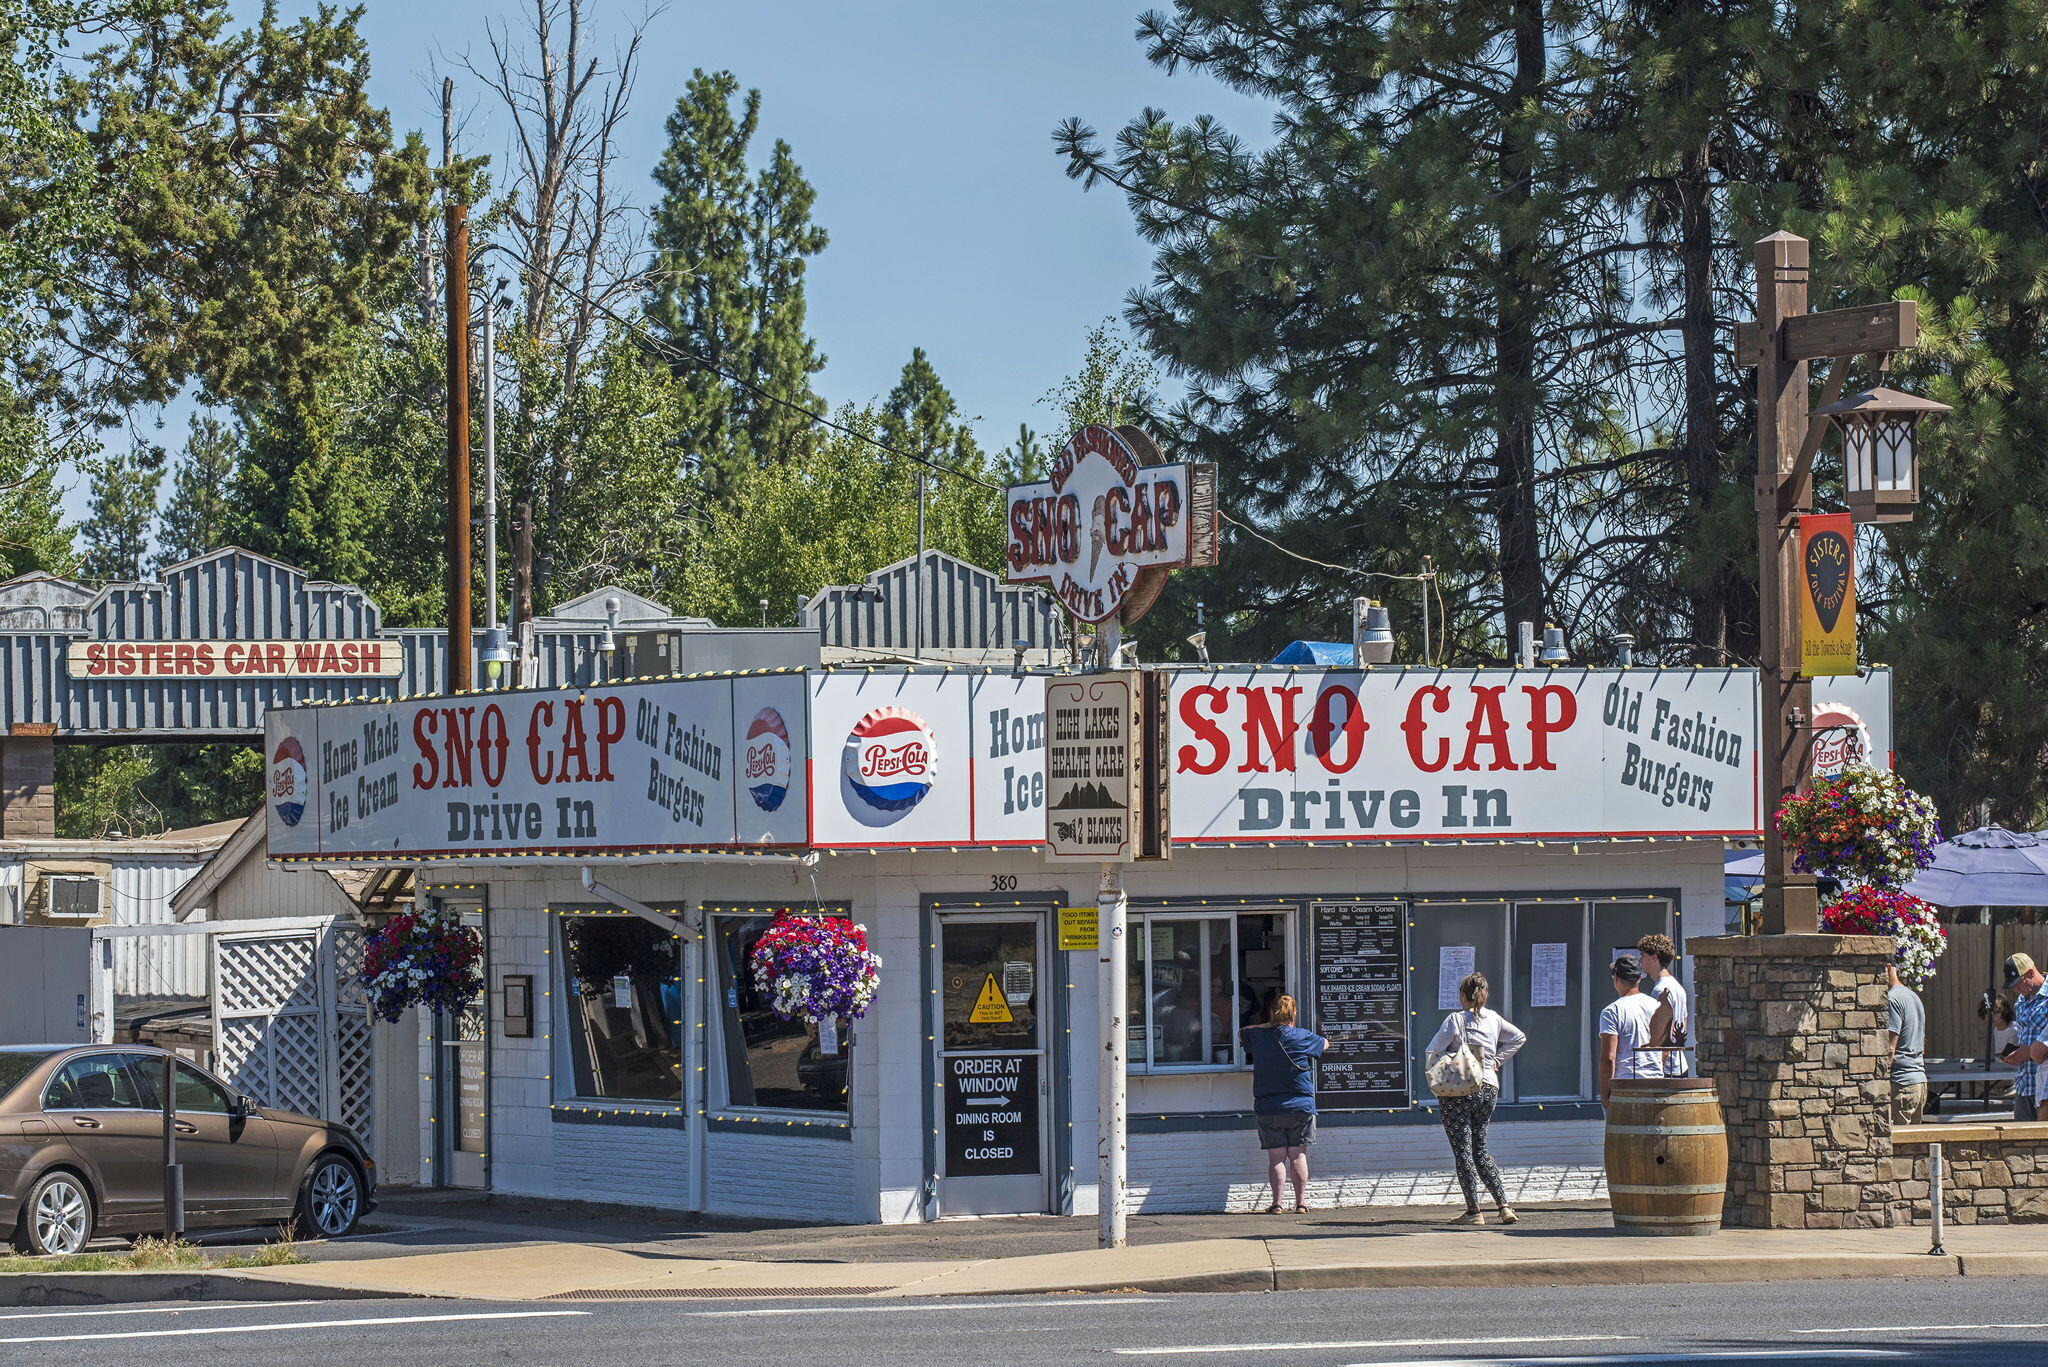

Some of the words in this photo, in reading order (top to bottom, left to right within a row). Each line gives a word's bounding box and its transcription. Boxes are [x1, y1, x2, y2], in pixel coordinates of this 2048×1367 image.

[1007, 493, 1082, 572] SNO
[1104, 480, 1181, 556] CAP
[1810, 537, 1846, 568] SISTERS
[1059, 573, 1105, 618] DRIVE
[1107, 562, 1132, 603] IN
[1810, 573, 1822, 605] FOLK
[1823, 570, 1846, 610] FESTIVAL
[86, 644, 216, 676] SISTERS
[224, 643, 286, 675] CAR
[295, 643, 382, 674] WASH
[412, 703, 509, 790] SNO
[526, 695, 626, 787] CAP
[635, 697, 659, 748] Old
[666, 712, 721, 782] Fashion
[990, 708, 1046, 759] Hom
[1056, 709, 1080, 740] HIGH
[1085, 707, 1120, 739] LAKES
[1177, 685, 1370, 775] SNO
[1400, 684, 1578, 772] CAP
[1603, 682, 1640, 734] Old
[1652, 698, 1742, 768] Fashion
[323, 738, 358, 784] Home
[363, 713, 399, 769] Made
[1052, 747, 1091, 778] HEALTH
[1094, 745, 1124, 777] CARE
[647, 759, 705, 828] Burgers
[1004, 766, 1043, 815] Ice
[1620, 743, 1714, 813] Burgers
[330, 790, 349, 833] Ice
[357, 769, 399, 820] Cream
[447, 792, 542, 842] Drive
[556, 796, 597, 838] In
[1238, 778, 1421, 831] Drive
[1442, 785, 1512, 827] In
[1077, 820, 1083, 844] 2
[1087, 817, 1122, 844] BLOCKS
[989, 875, 1018, 891] 380
[459, 1050, 477, 1062] ORDER
[460, 1066, 482, 1079] WINDOW
[954, 1059, 1002, 1075] ORDER
[1004, 1058, 1022, 1073] AT
[958, 1077, 1018, 1093] WINDOW
[463, 1128, 481, 1138] CLOSED
[956, 1112, 989, 1125] DINING
[992, 1111, 1021, 1124] ROOM
[983, 1130, 995, 1141] IS
[965, 1148, 1013, 1160] CLOSED
